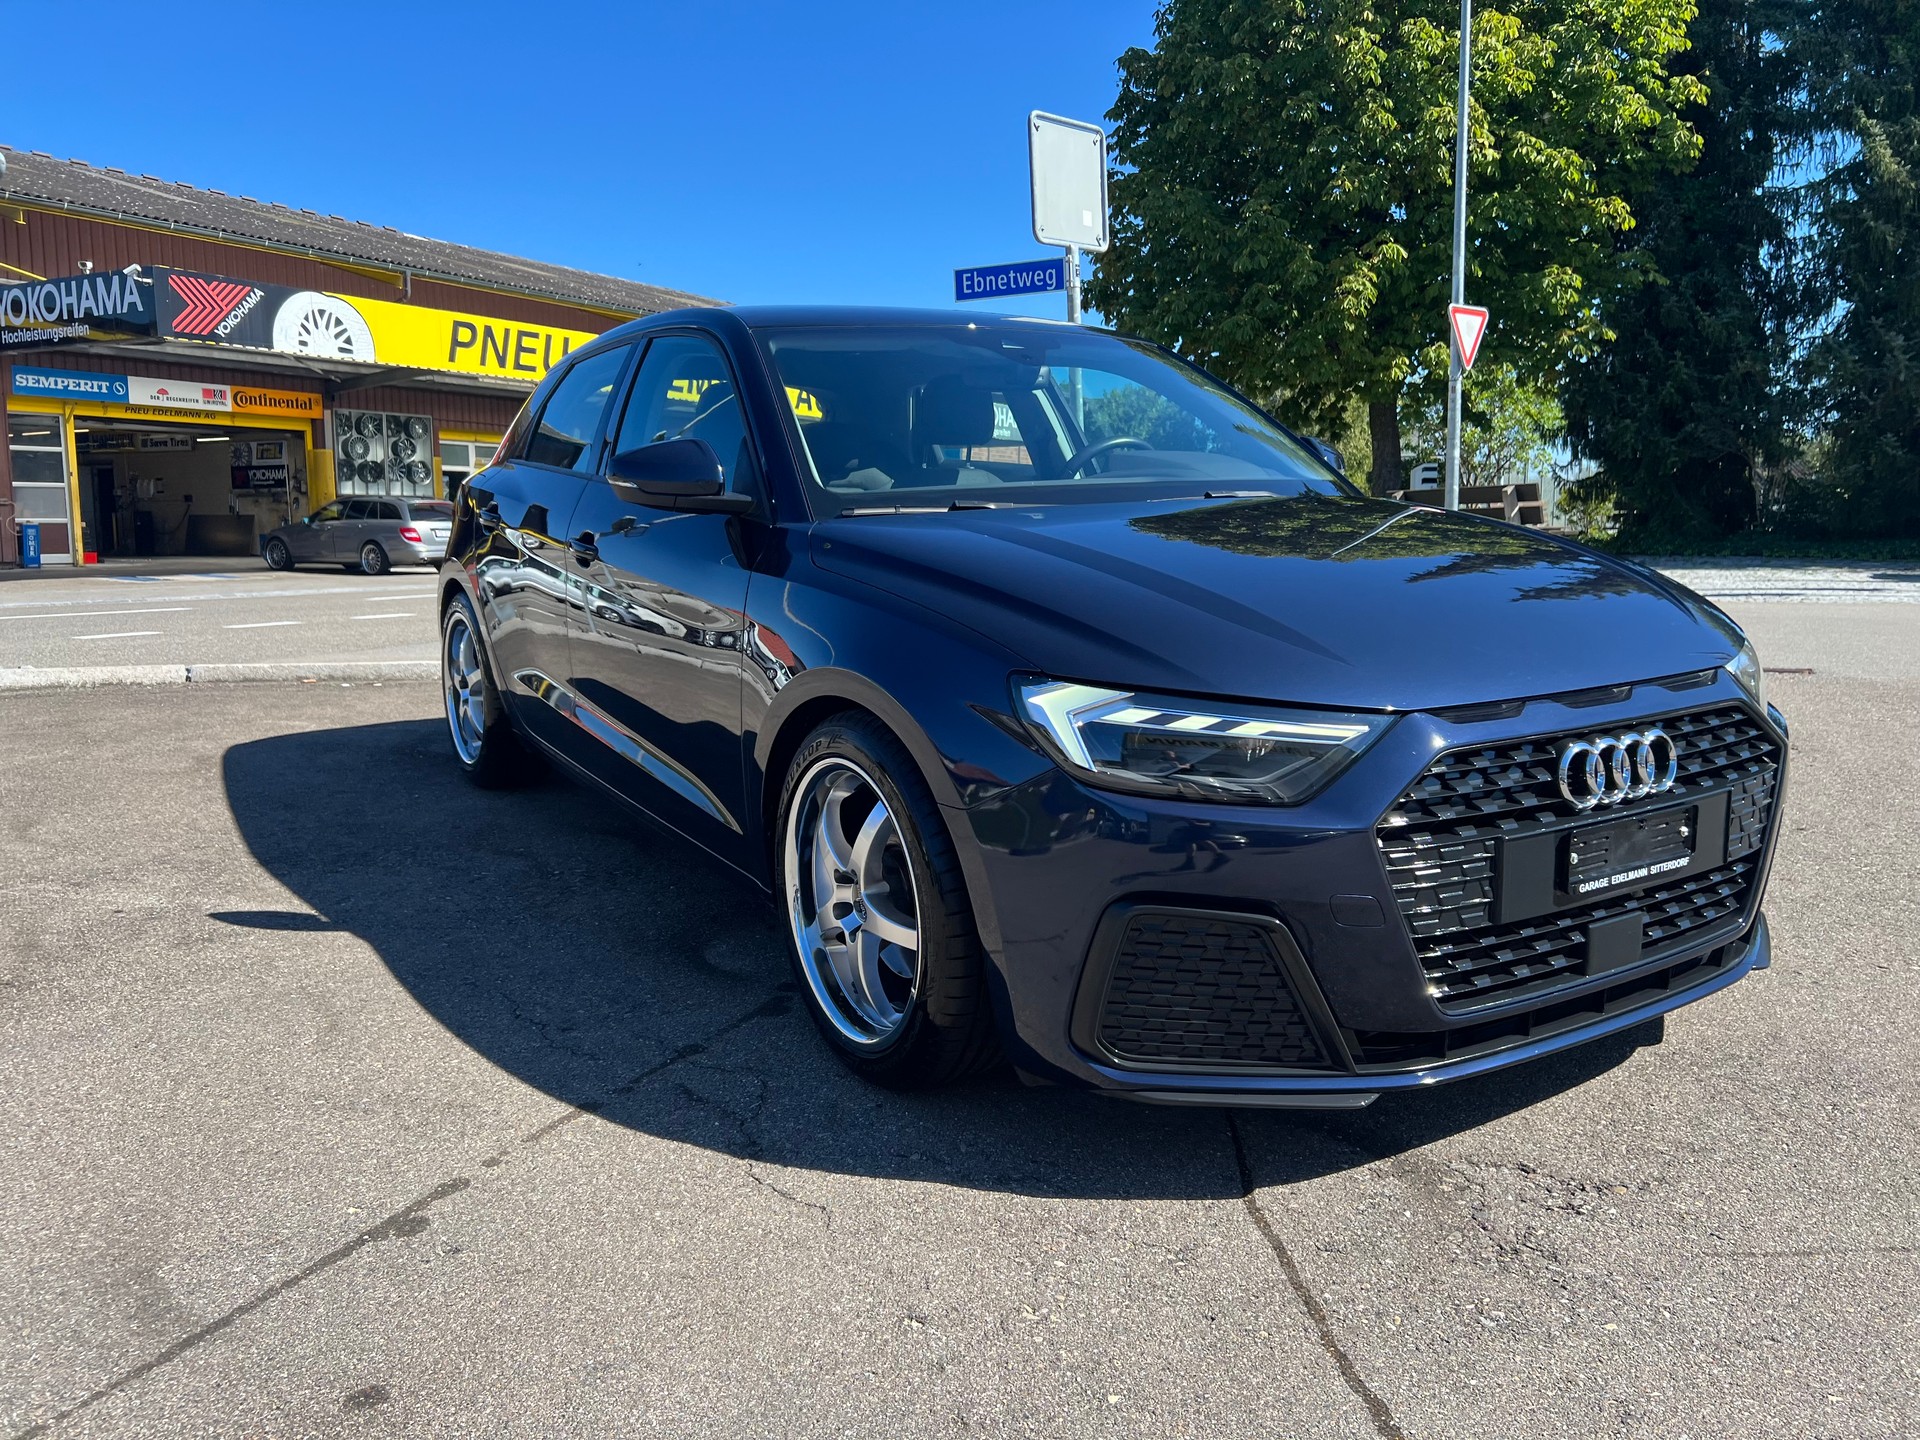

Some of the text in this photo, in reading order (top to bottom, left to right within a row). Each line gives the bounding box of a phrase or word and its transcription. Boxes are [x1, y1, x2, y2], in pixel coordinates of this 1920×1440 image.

[962, 268, 1057, 294] Ebnetweg
[0, 275, 143, 327] YOKOHAMA
[213, 287, 265, 338] YOKOHAMA
[1, 323, 90, 344] Hochleistungsreifen
[448, 319, 570, 373] PNEU
[15, 374, 109, 393] SEMPERIT
[125, 406, 216, 420] PNEU EDELMANN AG
[233, 390, 313, 411] Continental
[1579, 856, 1690, 893] GARAGE EDELMANN SITTERDORF
